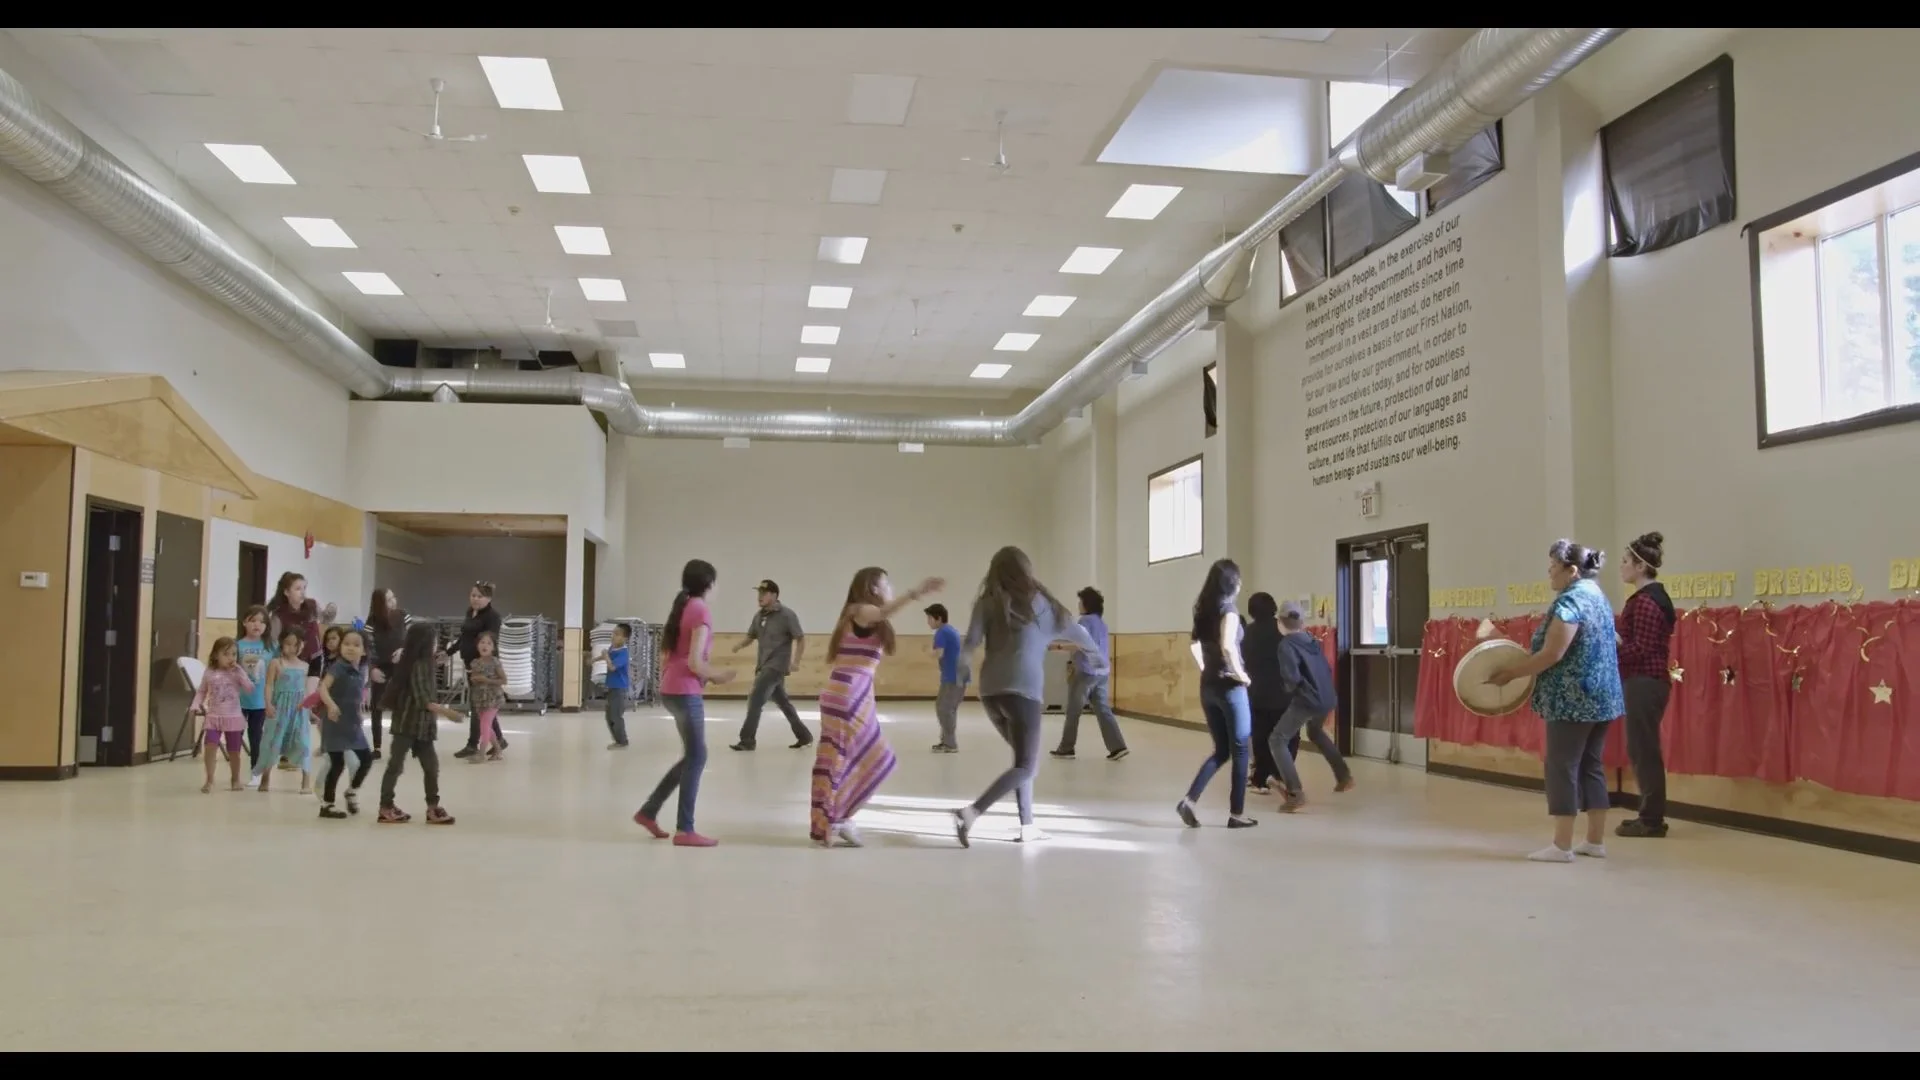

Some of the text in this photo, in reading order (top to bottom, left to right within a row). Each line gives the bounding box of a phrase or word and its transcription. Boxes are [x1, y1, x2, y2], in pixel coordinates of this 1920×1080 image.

[1379, 258, 1385, 272] in
[1386, 251, 1399, 267] the
[1400, 231, 1433, 259] exercise
[1436, 221, 1444, 238] of
[1446, 214, 1460, 232] our
[1305, 237, 1462, 331] inherent right of self-government, and having
[1305, 324, 1334, 349] aboriginal
[1371, 297, 1385, 315] and
[1387, 281, 1420, 308] interests
[1421, 269, 1443, 289] since
[1445, 257, 1464, 276] time
[1345, 337, 1351, 348] in
[1352, 334, 1356, 345] a
[1373, 319, 1389, 334] area
[1391, 309, 1399, 324] of
[1400, 300, 1419, 320] land,
[1421, 295, 1431, 310] do
[1433, 281, 1460, 304] herein
[1315, 386, 1325, 398] our
[1326, 382, 1337, 393] law
[1338, 373, 1350, 389] and
[1351, 369, 1361, 381] for
[1362, 364, 1374, 378] our
[1375, 342, 1422, 376] government,
[1424, 337, 1431, 350] in
[1432, 327, 1456, 346] order
[1457, 321, 1467, 336] to
[1335, 349, 1366, 371] ourselves
[1367, 346, 1371, 356] a
[1373, 336, 1391, 353] basis
[1393, 330, 1404, 343] for
[1405, 323, 1419, 338] our
[1420, 311, 1439, 331] First
[1441, 299, 1472, 321] Nation,
[1305, 360, 1470, 440] generations in the future, protection of our land
[1308, 345, 1465, 419] Assure for ourselves today, and for countless
[1307, 442, 1317, 454] and
[1353, 418, 1388, 441] protection
[1389, 410, 1397, 425] of
[1398, 408, 1412, 422] our
[1413, 395, 1450, 417] language
[1452, 384, 1468, 403] and
[1333, 449, 1344, 463] and
[1345, 446, 1355, 459] life
[1356, 441, 1369, 455] that
[1394, 431, 1406, 443] our
[1408, 415, 1454, 439] uniqueness
[1456, 411, 1467, 423] as
[1313, 435, 1461, 487] human beings and sustains our well-being.
[1362, 496, 1372, 515] EXIT
[1754, 562, 1865, 602] DREAMS,
